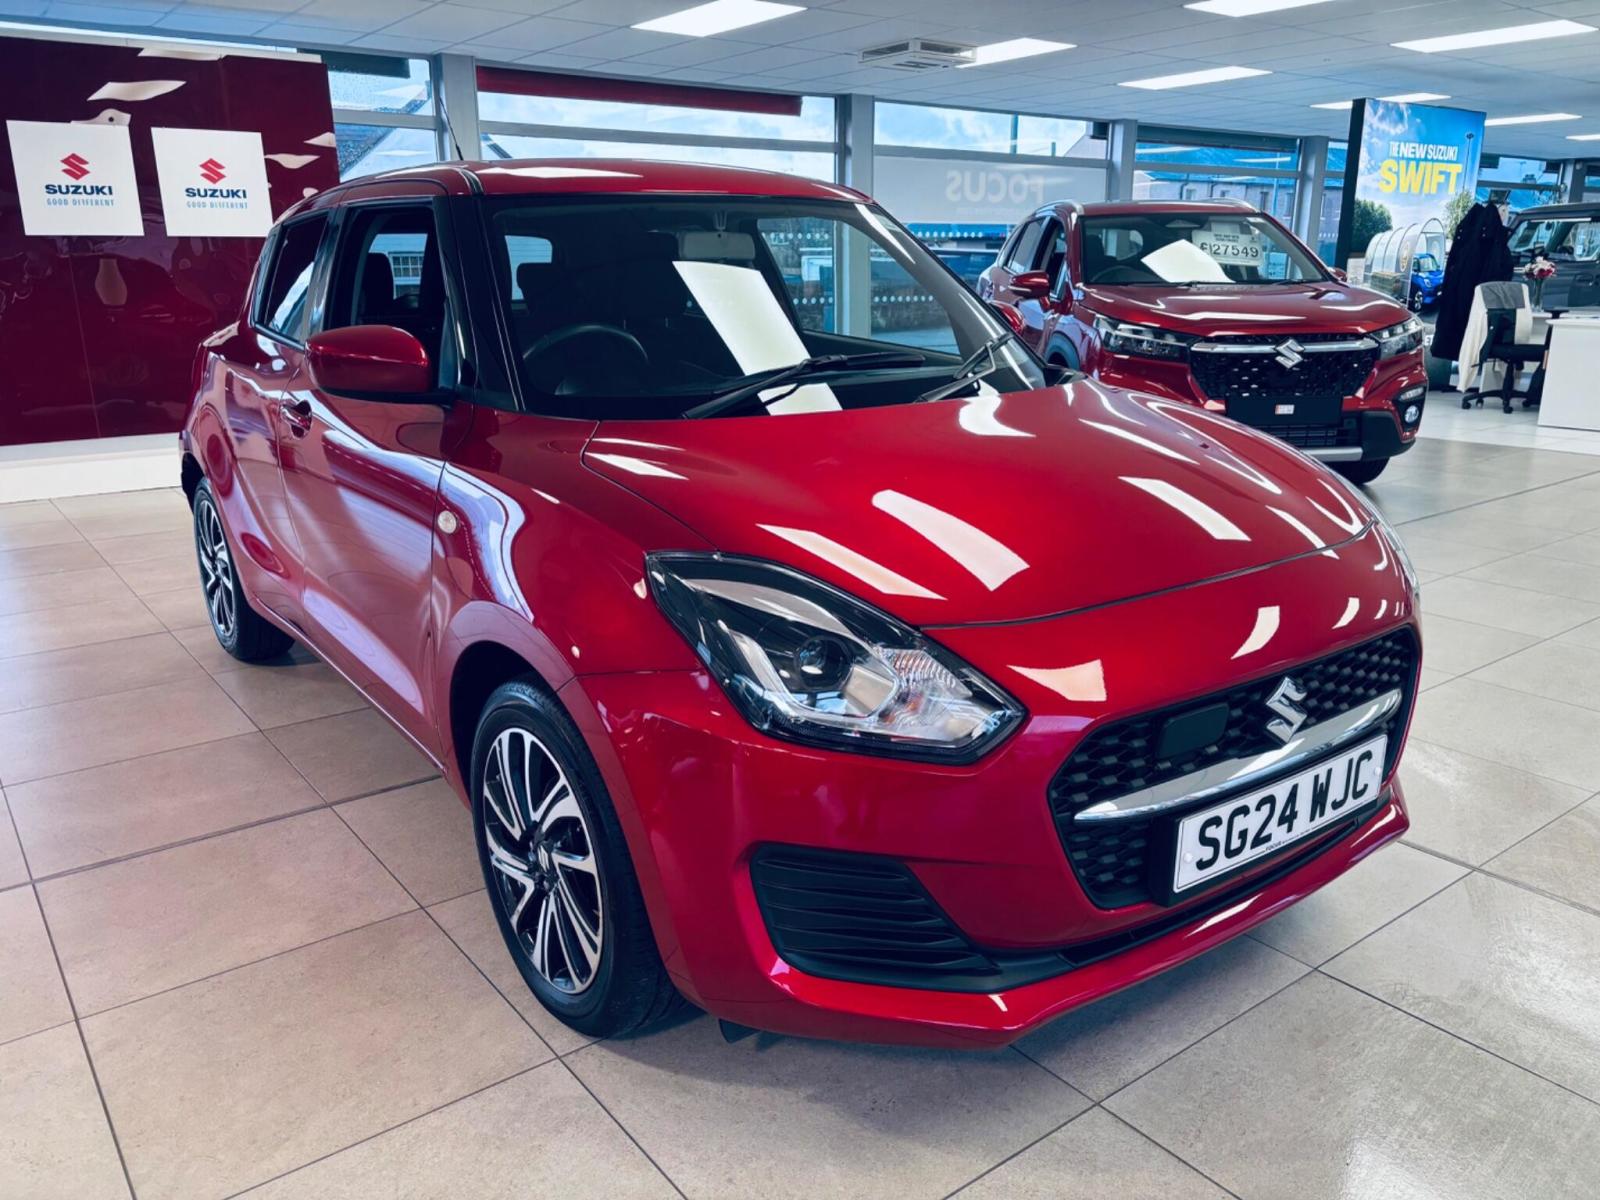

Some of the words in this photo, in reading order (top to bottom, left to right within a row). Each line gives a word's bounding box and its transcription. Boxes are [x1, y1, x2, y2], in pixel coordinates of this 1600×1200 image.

[1400, 142, 1428, 159] NEW
[1427, 145, 1458, 160] SUZUKI
[1378, 159, 1463, 195] SWIFT
[45, 184, 113, 196] SUZUKI
[185, 187, 247, 199] SUZUKI
[46, 198, 69, 207] GOOD
[72, 199, 115, 207] DIFFERENT
[186, 200, 207, 208] GOOD
[1195, 783, 1299, 871] SG24
[1309, 749, 1373, 823] WJC
